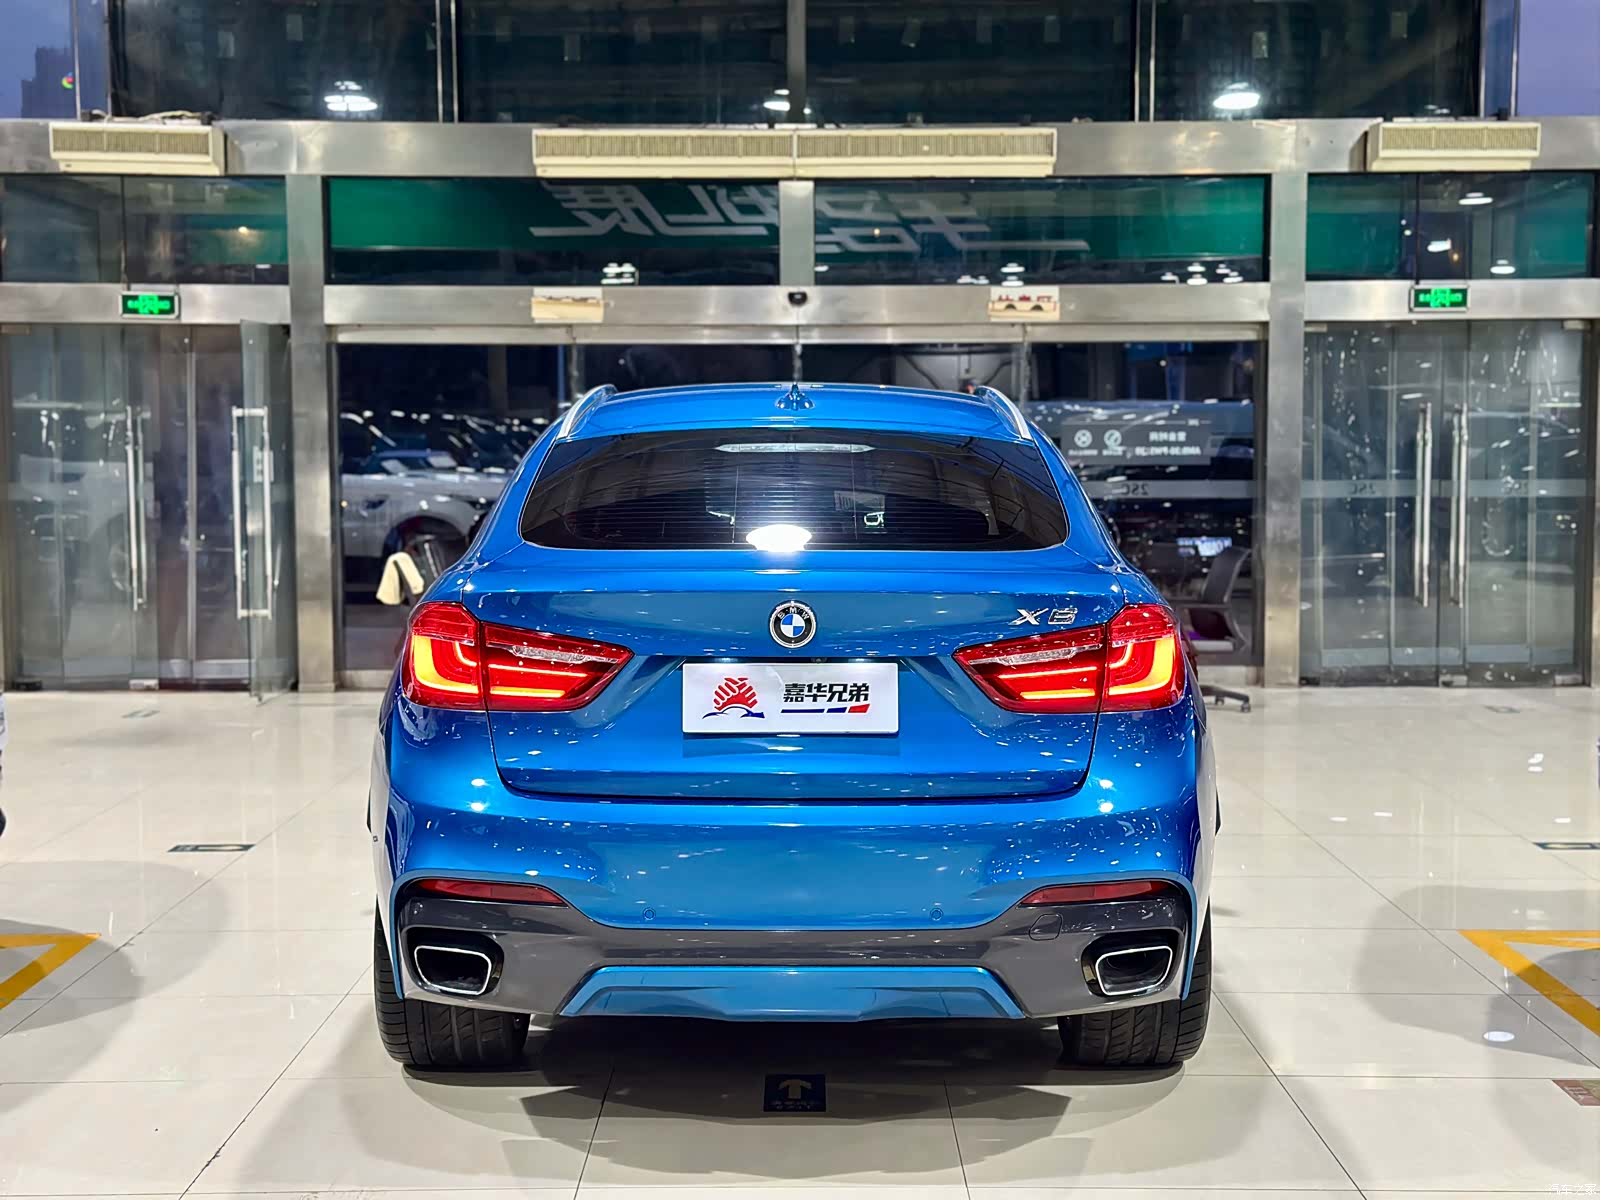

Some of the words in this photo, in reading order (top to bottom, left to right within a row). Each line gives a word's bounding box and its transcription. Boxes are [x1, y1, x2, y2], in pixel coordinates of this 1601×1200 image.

[777, 606, 810, 620] BMW
[1008, 607, 1078, 625] X6
[783, 683, 869, 703] 嘉华兄弟
